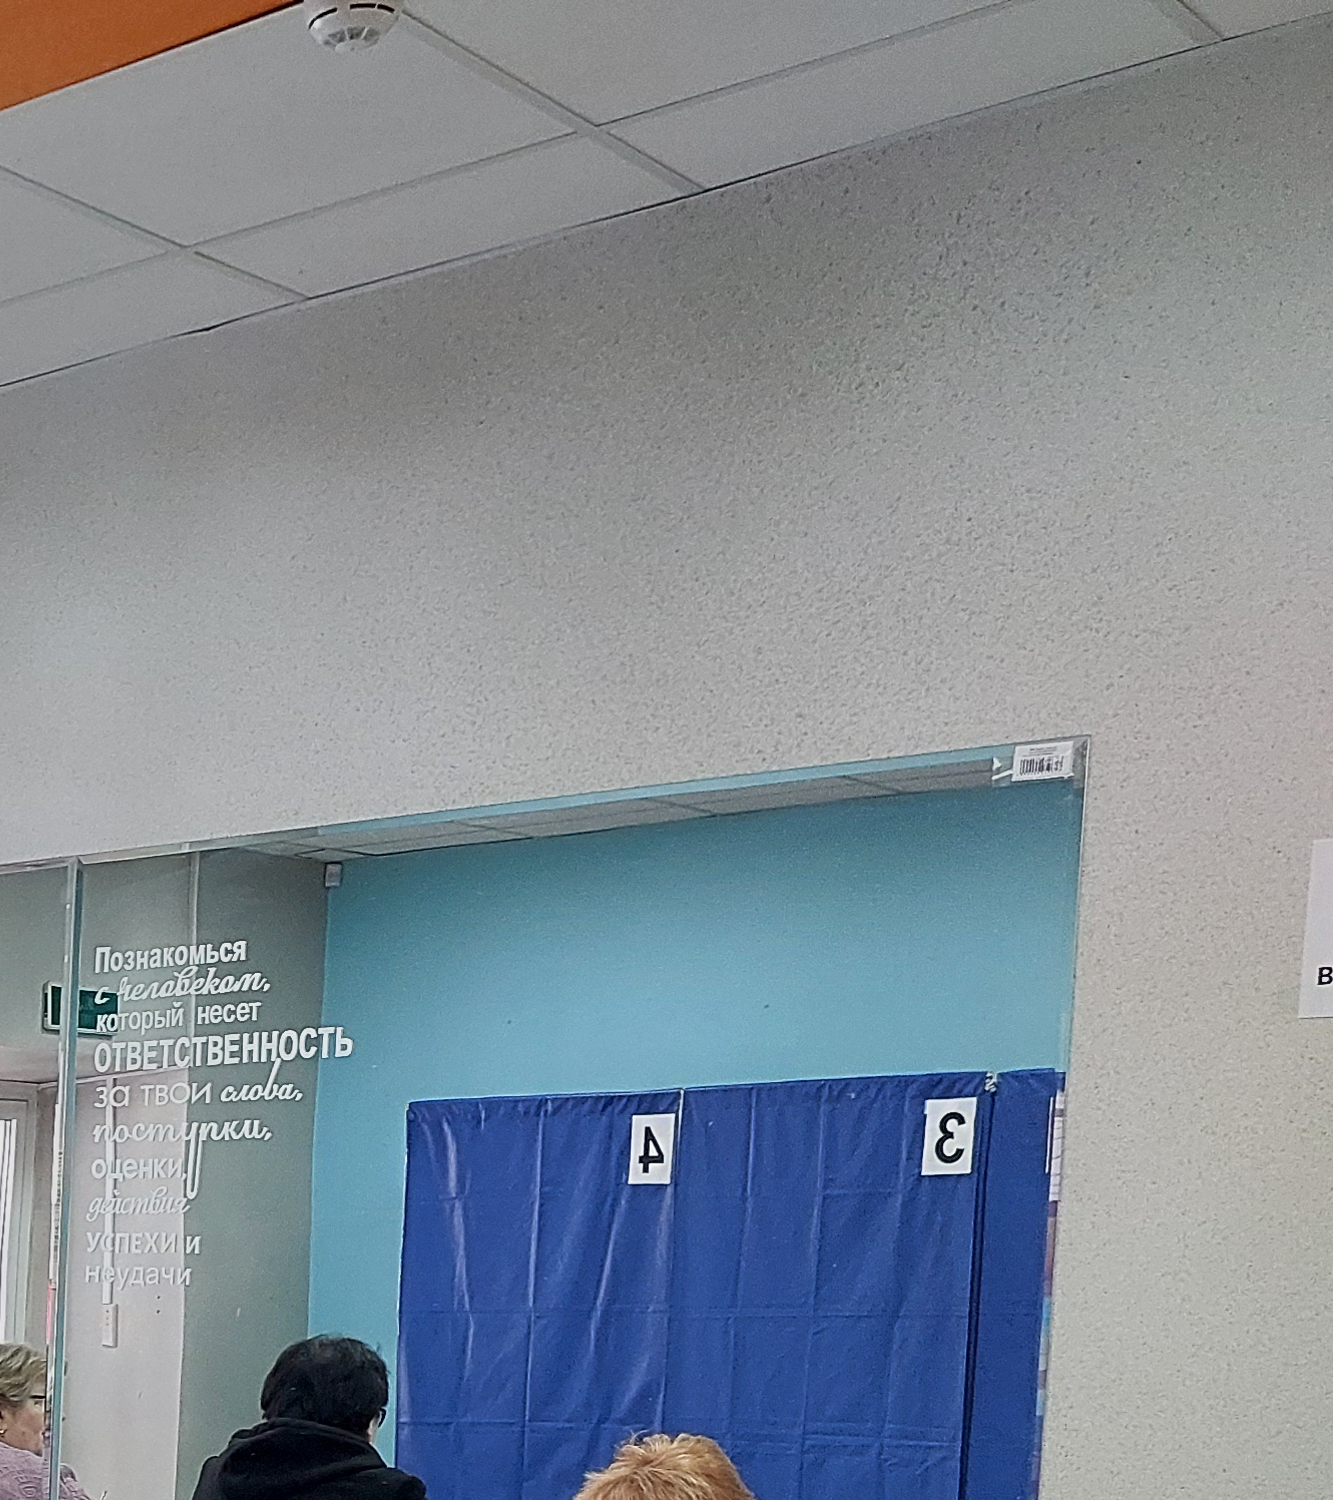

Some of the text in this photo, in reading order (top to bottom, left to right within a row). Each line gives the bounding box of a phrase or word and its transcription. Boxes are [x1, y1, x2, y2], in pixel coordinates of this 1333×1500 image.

[94, 941, 247, 974] Познакомься
[94, 965, 271, 1005] с человеком,
[96, 1001, 263, 1035] который несет
[94, 1026, 354, 1073] ОТВЕТСТВЕННОСТЬ
[91, 1157, 188, 1182] оценки,
[85, 1265, 193, 1290] неудачи
